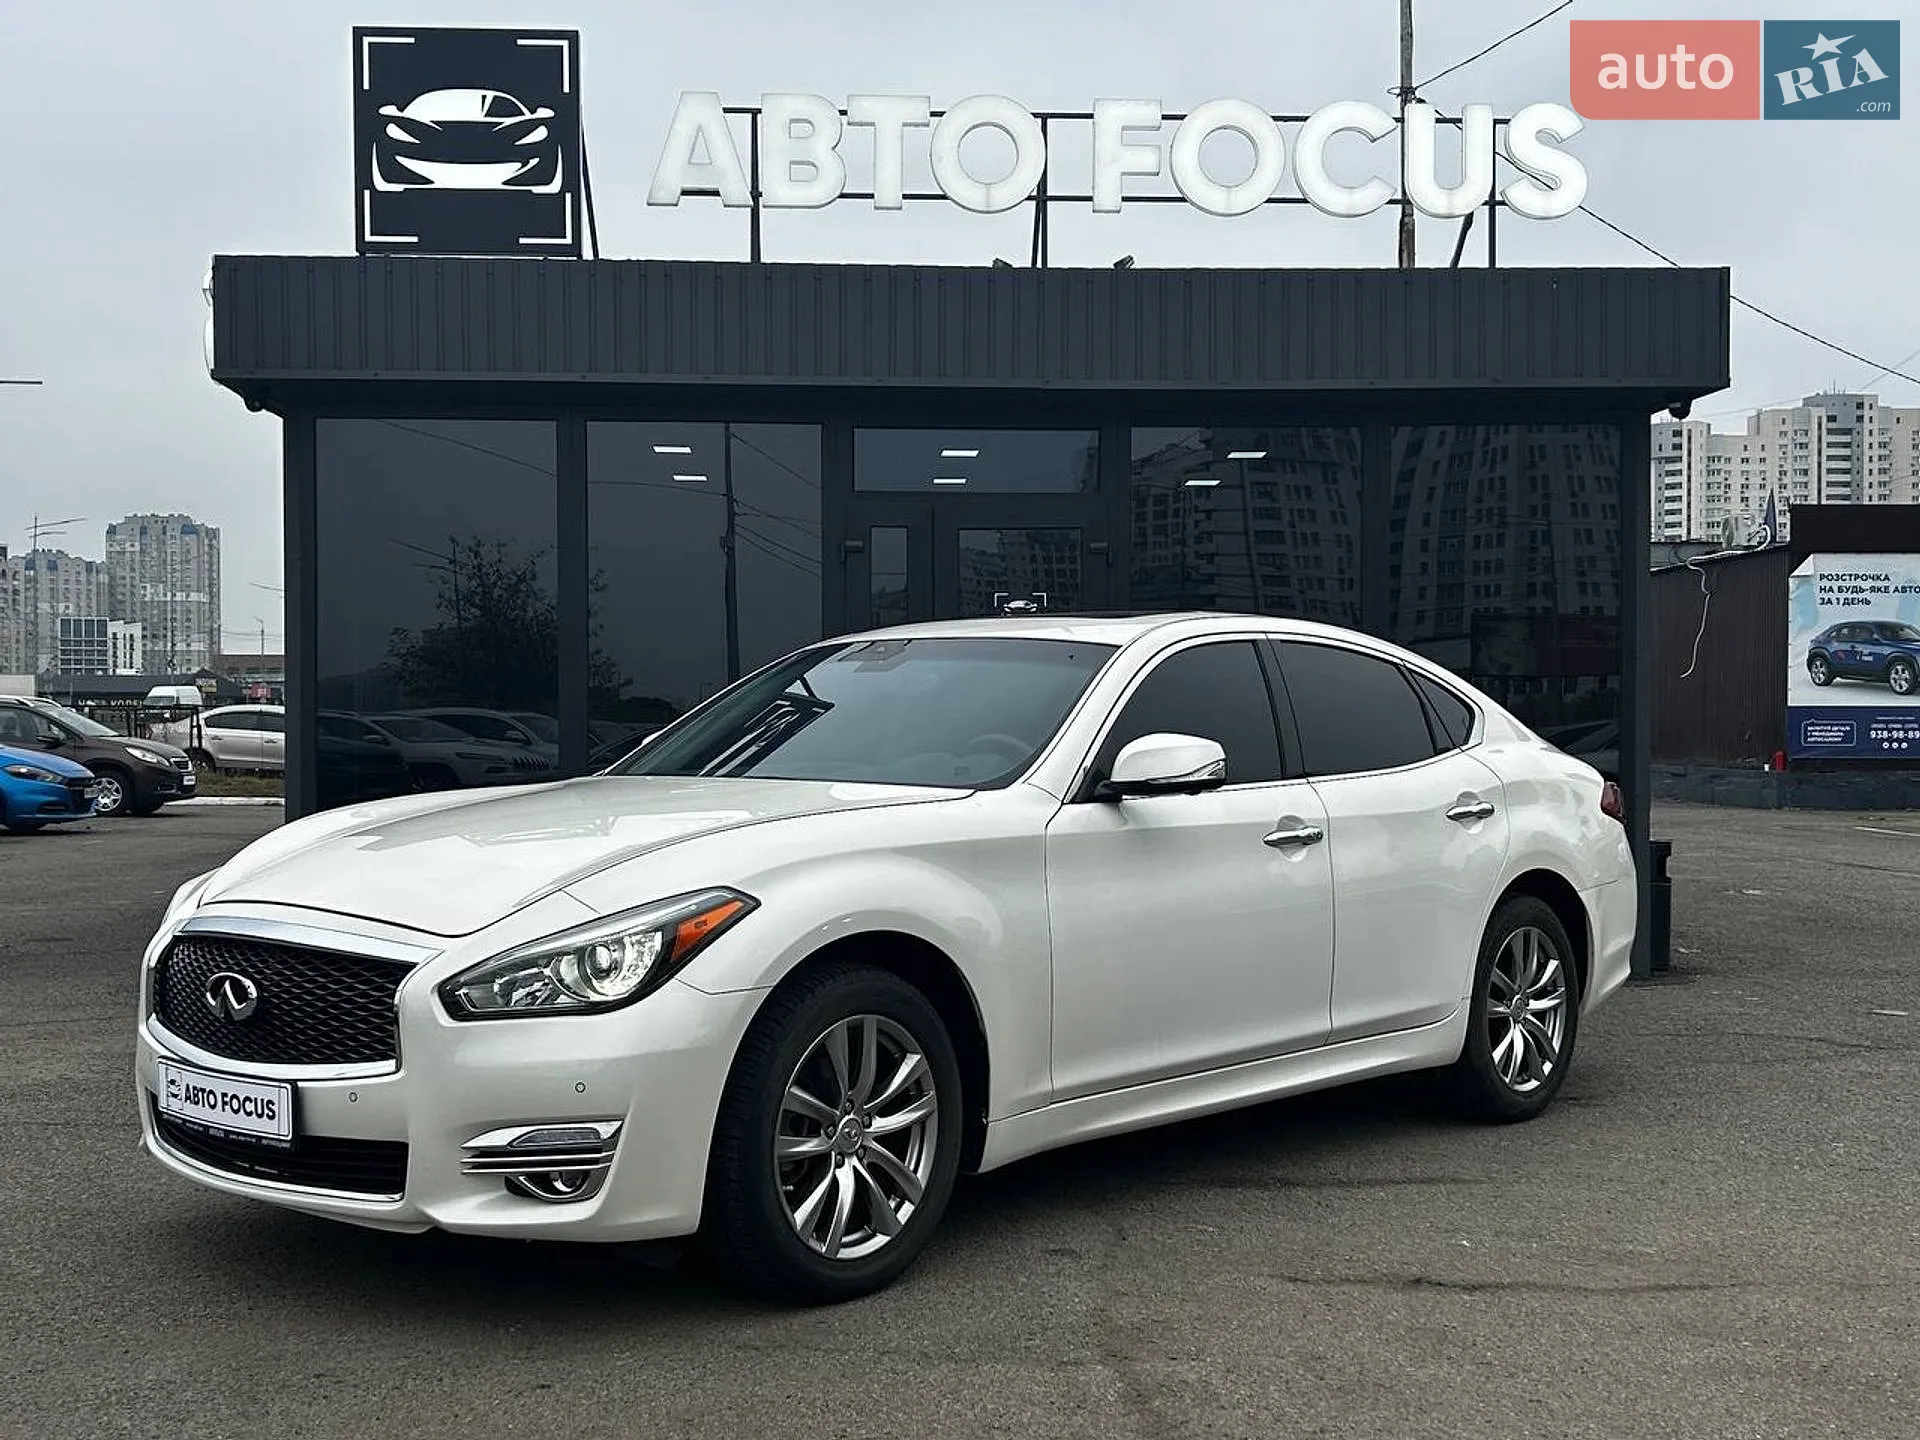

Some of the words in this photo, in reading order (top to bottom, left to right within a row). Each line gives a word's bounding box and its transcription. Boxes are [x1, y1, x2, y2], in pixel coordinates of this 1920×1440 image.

[646, 90, 1047, 214] АВТО
[1092, 98, 1590, 220] FOCUS
[1819, 573, 1891, 582] РОЗСТРОЧКА
[1819, 585, 1834, 594] НА
[1837, 585, 1890, 594] БУДЬ-ЯКЕ
[1819, 597, 1833, 606] ЗА
[1835, 597, 1841, 606] 1
[1842, 597, 1871, 606] ДЕНЬ
[184, 1083, 217, 1110] АВТО
[221, 1091, 276, 1120] FOCUS
